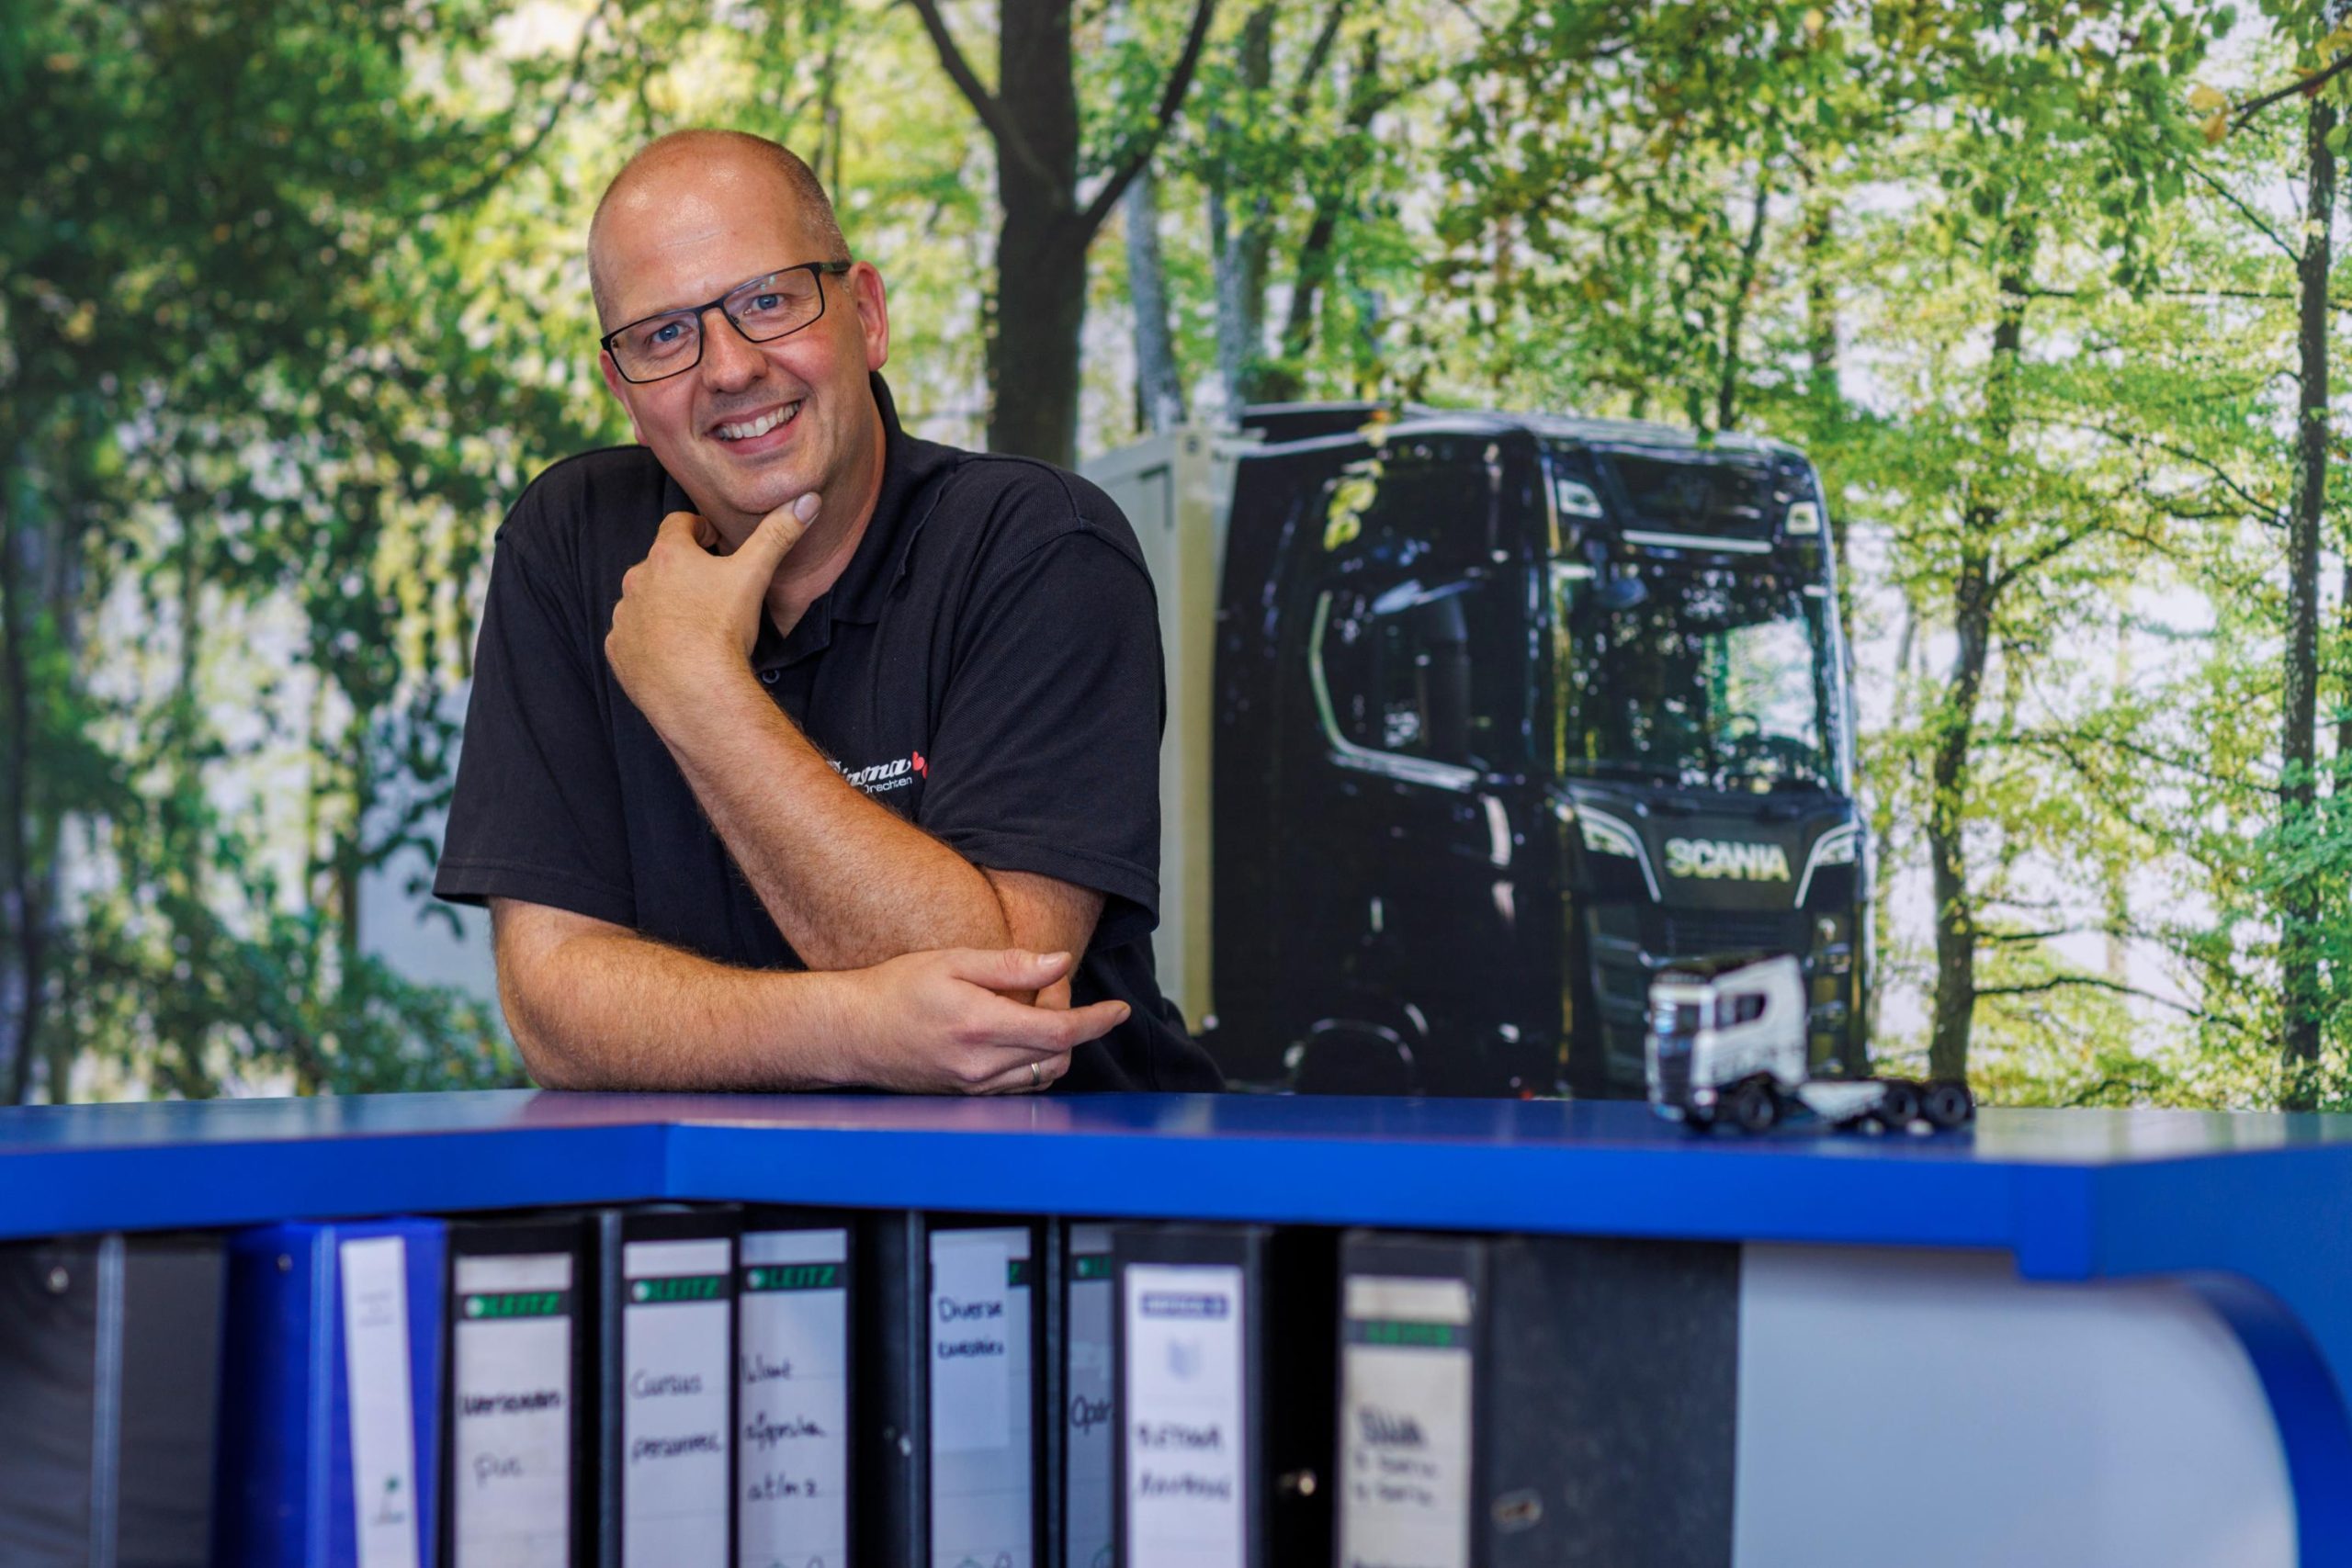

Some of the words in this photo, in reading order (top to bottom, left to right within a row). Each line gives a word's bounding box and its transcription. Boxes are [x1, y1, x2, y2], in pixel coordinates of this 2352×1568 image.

[1665, 838, 1791, 882] SCANIA
[651, 1278, 720, 1300] LEITZ
[770, 1266, 835, 1287] LEITZ
[484, 1292, 560, 1317] LEITZ
[938, 1295, 1003, 1323] Diverse
[630, 1368, 703, 1400] Cursus
